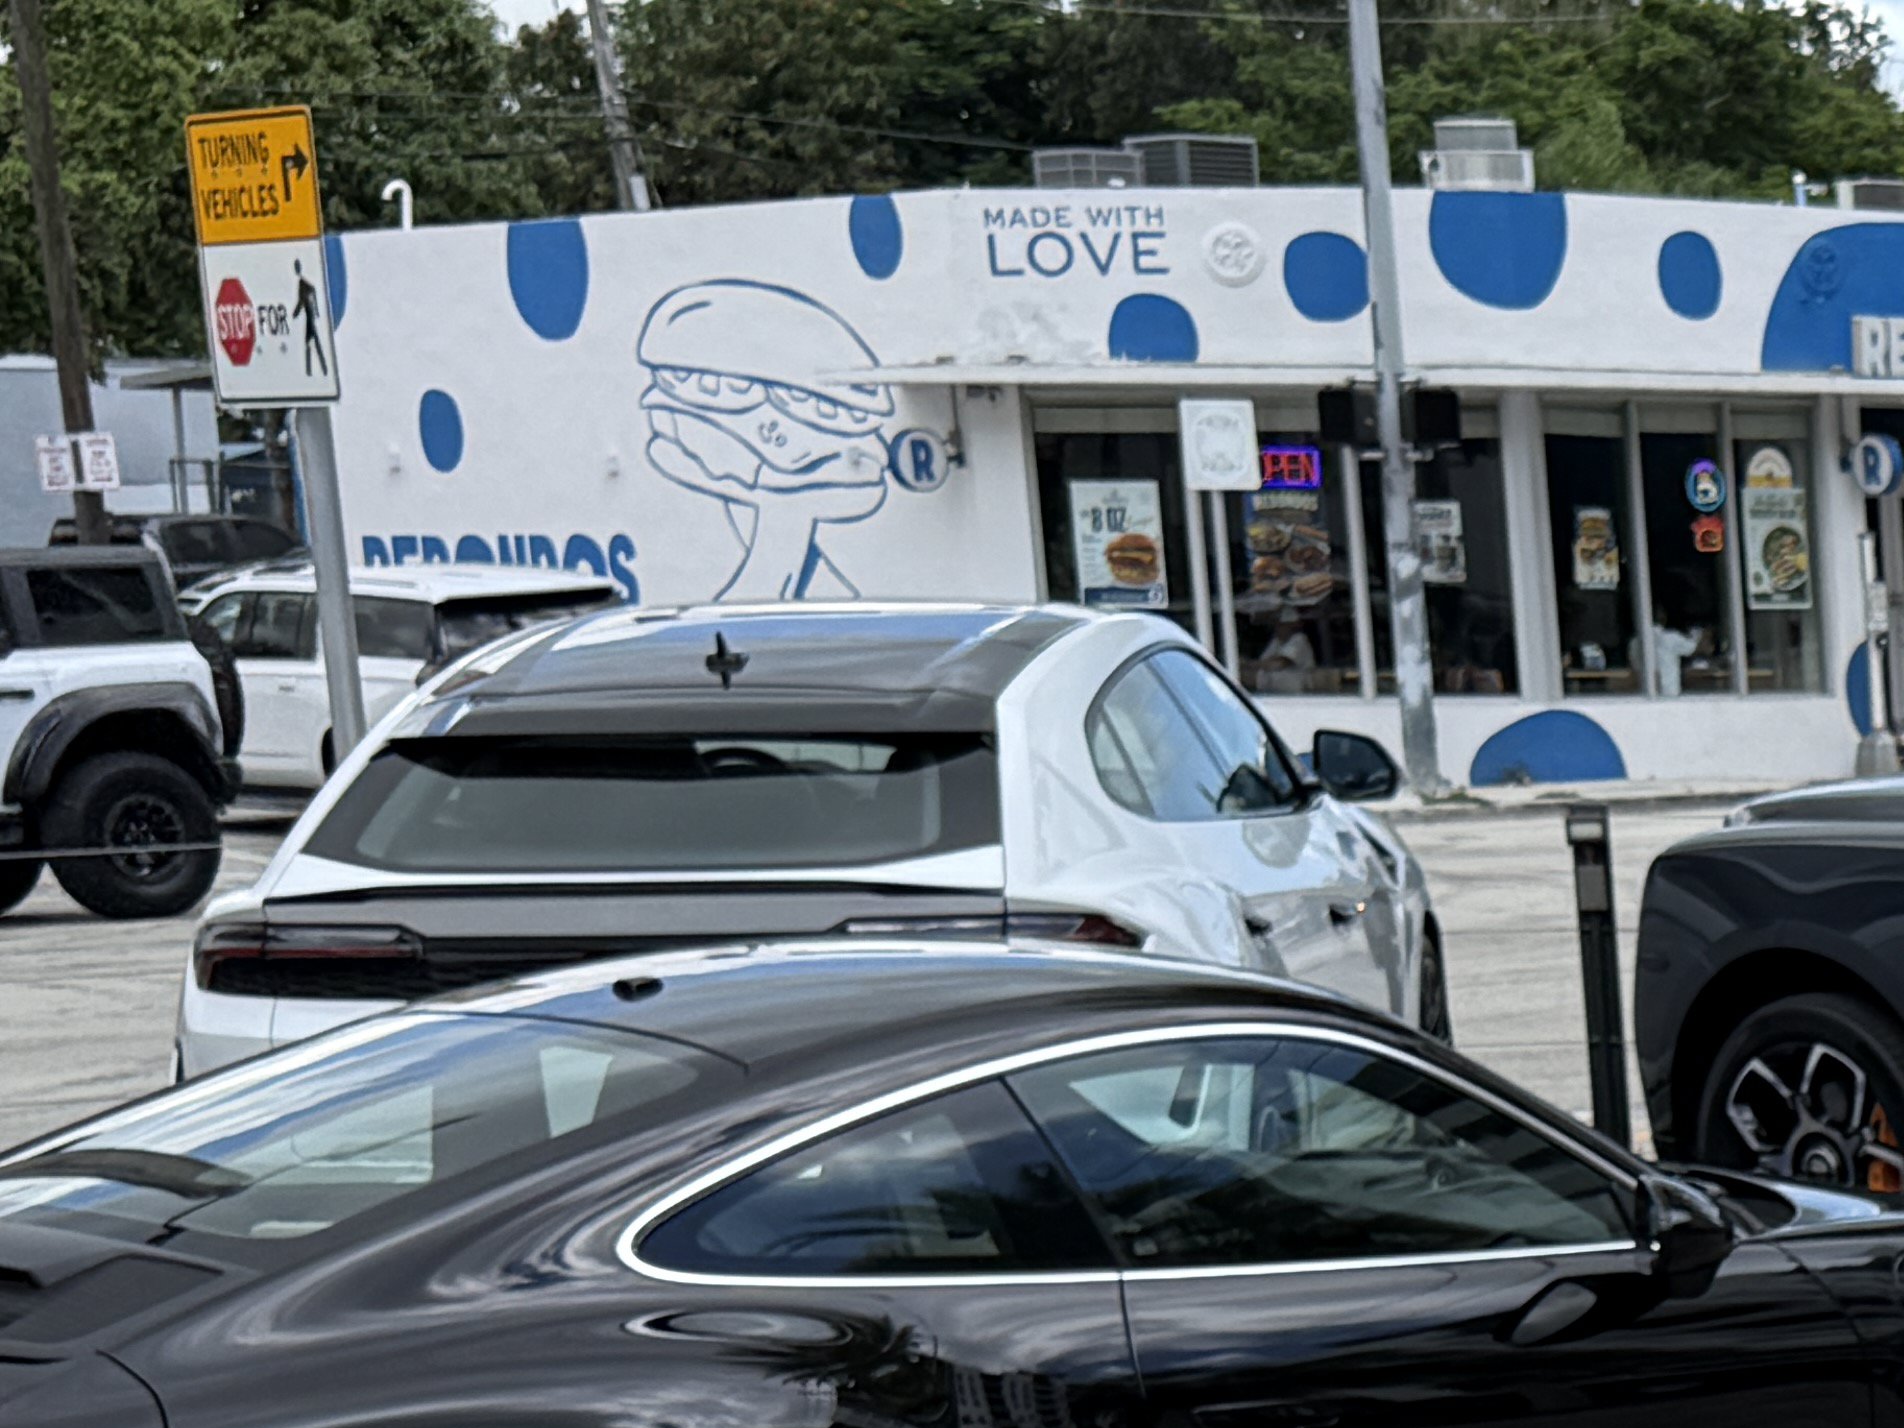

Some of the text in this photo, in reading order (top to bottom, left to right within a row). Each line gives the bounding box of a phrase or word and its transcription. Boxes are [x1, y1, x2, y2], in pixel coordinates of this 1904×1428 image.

[198, 131, 270, 169] TURNING
[200, 184, 280, 220] VEHICLES
[983, 205, 1165, 228] MADE WITH
[986, 231, 1170, 277] LOVE
[217, 303, 290, 340] STOP FOR
[911, 439, 935, 482] R
